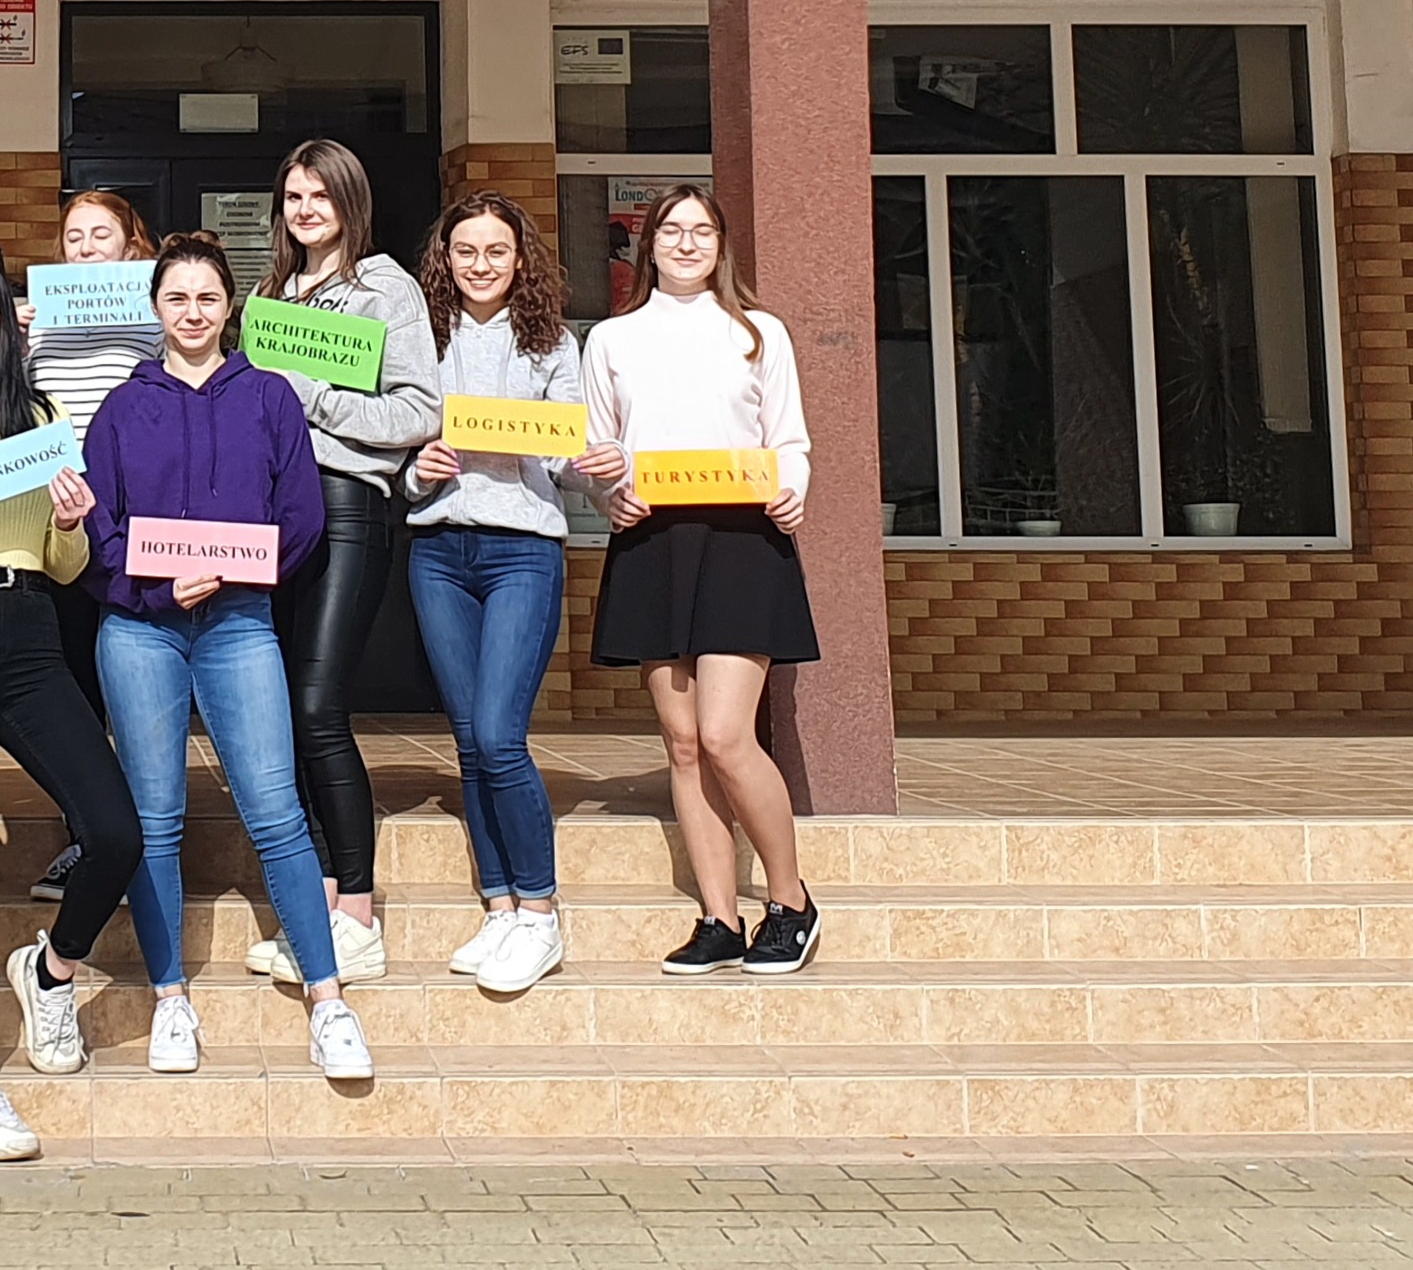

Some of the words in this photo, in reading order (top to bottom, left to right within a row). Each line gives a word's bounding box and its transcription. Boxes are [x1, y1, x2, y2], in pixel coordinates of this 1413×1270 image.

[67, 295, 127, 310] PORTÓW
[53, 315, 58, 325] I
[66, 311, 142, 325] TERMINALI
[250, 319, 372, 352] ARCHITEKTURA
[255, 336, 361, 367] KRAJOBRAZU
[453, 416, 576, 437] LOGISTYKA
[641, 470, 769, 484] TURYSTYKA
[141, 541, 268, 561] HOTELARSTWO
